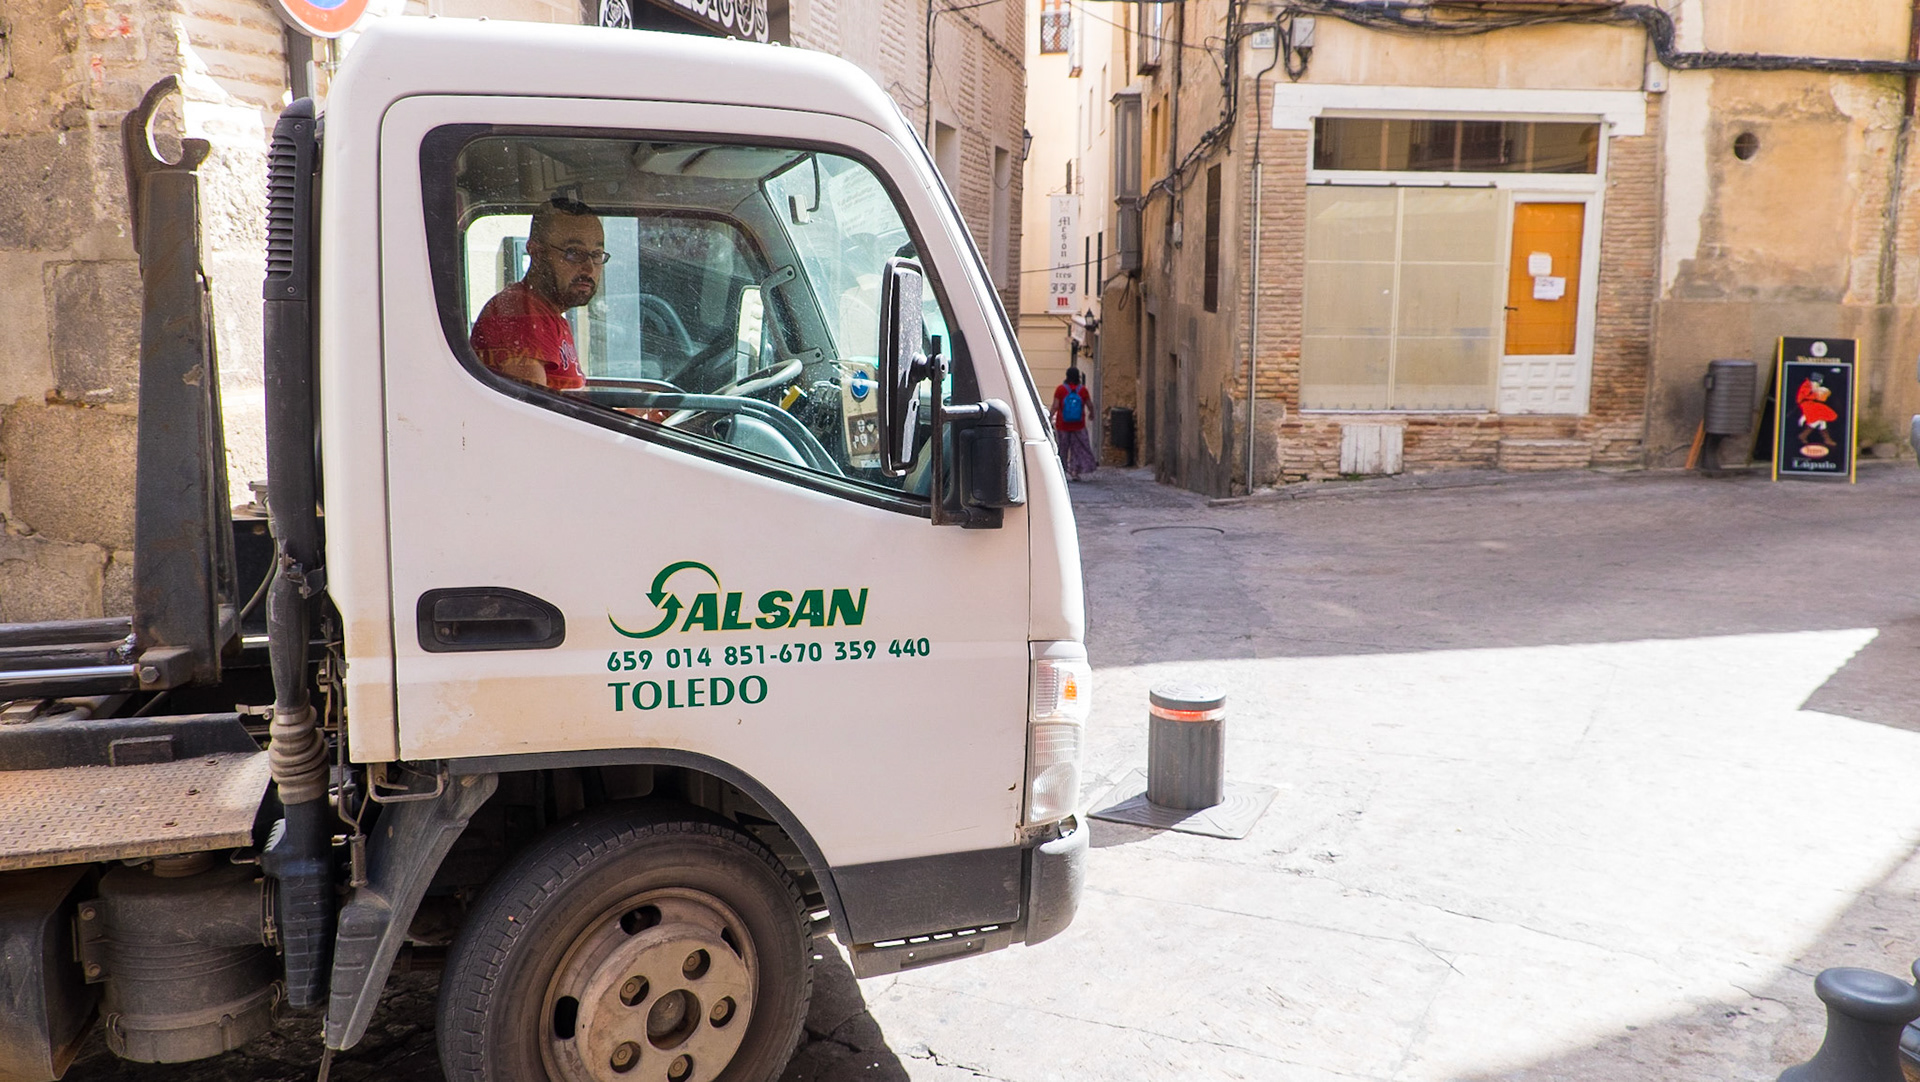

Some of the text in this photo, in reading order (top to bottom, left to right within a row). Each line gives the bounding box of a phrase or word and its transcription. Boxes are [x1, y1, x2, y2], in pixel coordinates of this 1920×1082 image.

[606, 637, 930, 672] 659 014 851-670 359 440
[607, 675, 769, 712] TOLEDO
